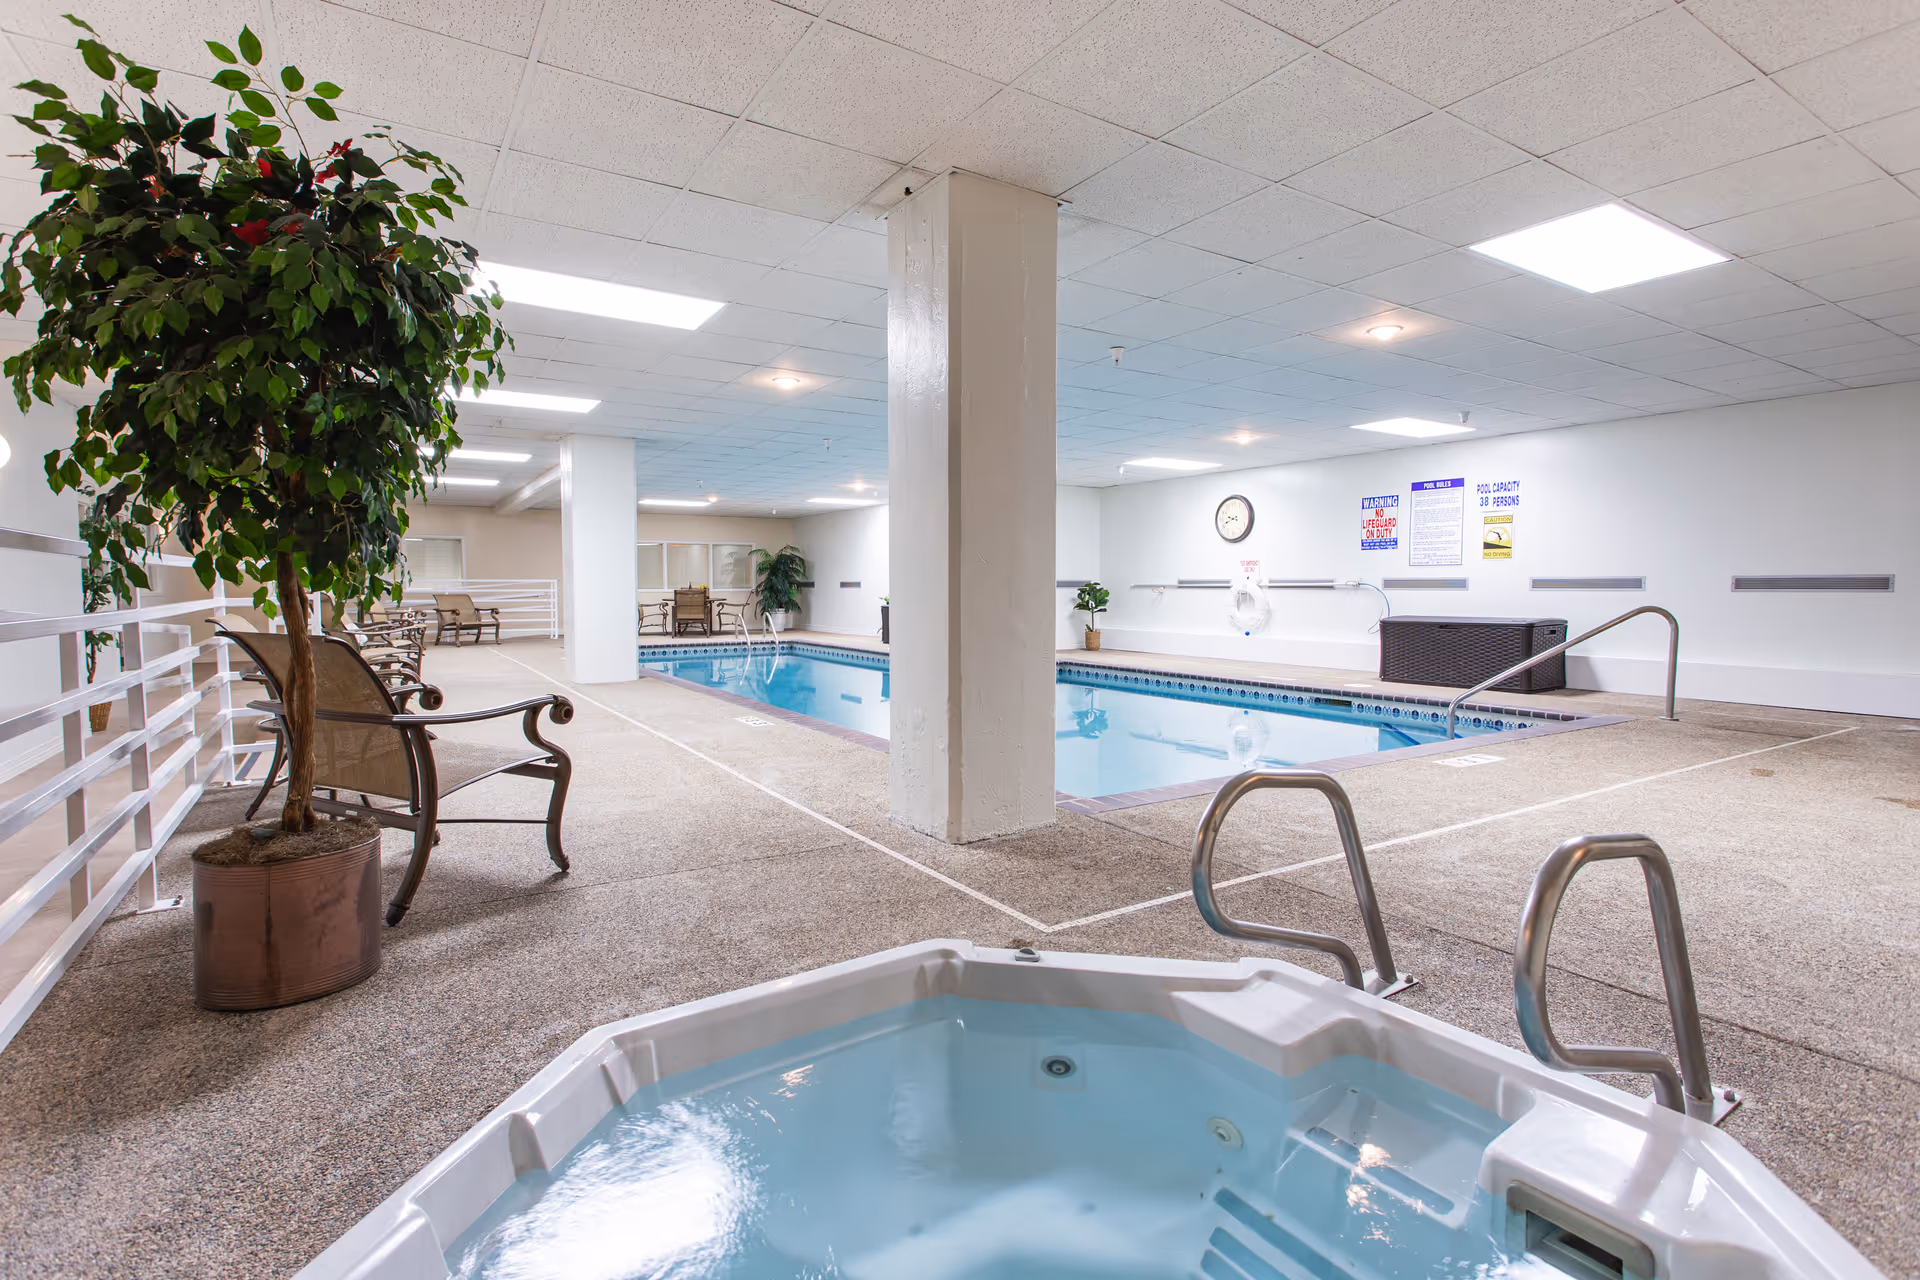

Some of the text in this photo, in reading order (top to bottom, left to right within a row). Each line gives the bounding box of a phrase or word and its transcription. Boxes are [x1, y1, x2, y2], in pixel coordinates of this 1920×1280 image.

[1477, 480, 1520, 494] POOL CAPACITY
[1363, 496, 1398, 508] WARNING
[1480, 495, 1519, 507] 38 PERSONS
[1375, 508, 1384, 518] NO
[1362, 517, 1396, 529] LIFEGUARD
[1366, 528, 1392, 539] ON DUTY
